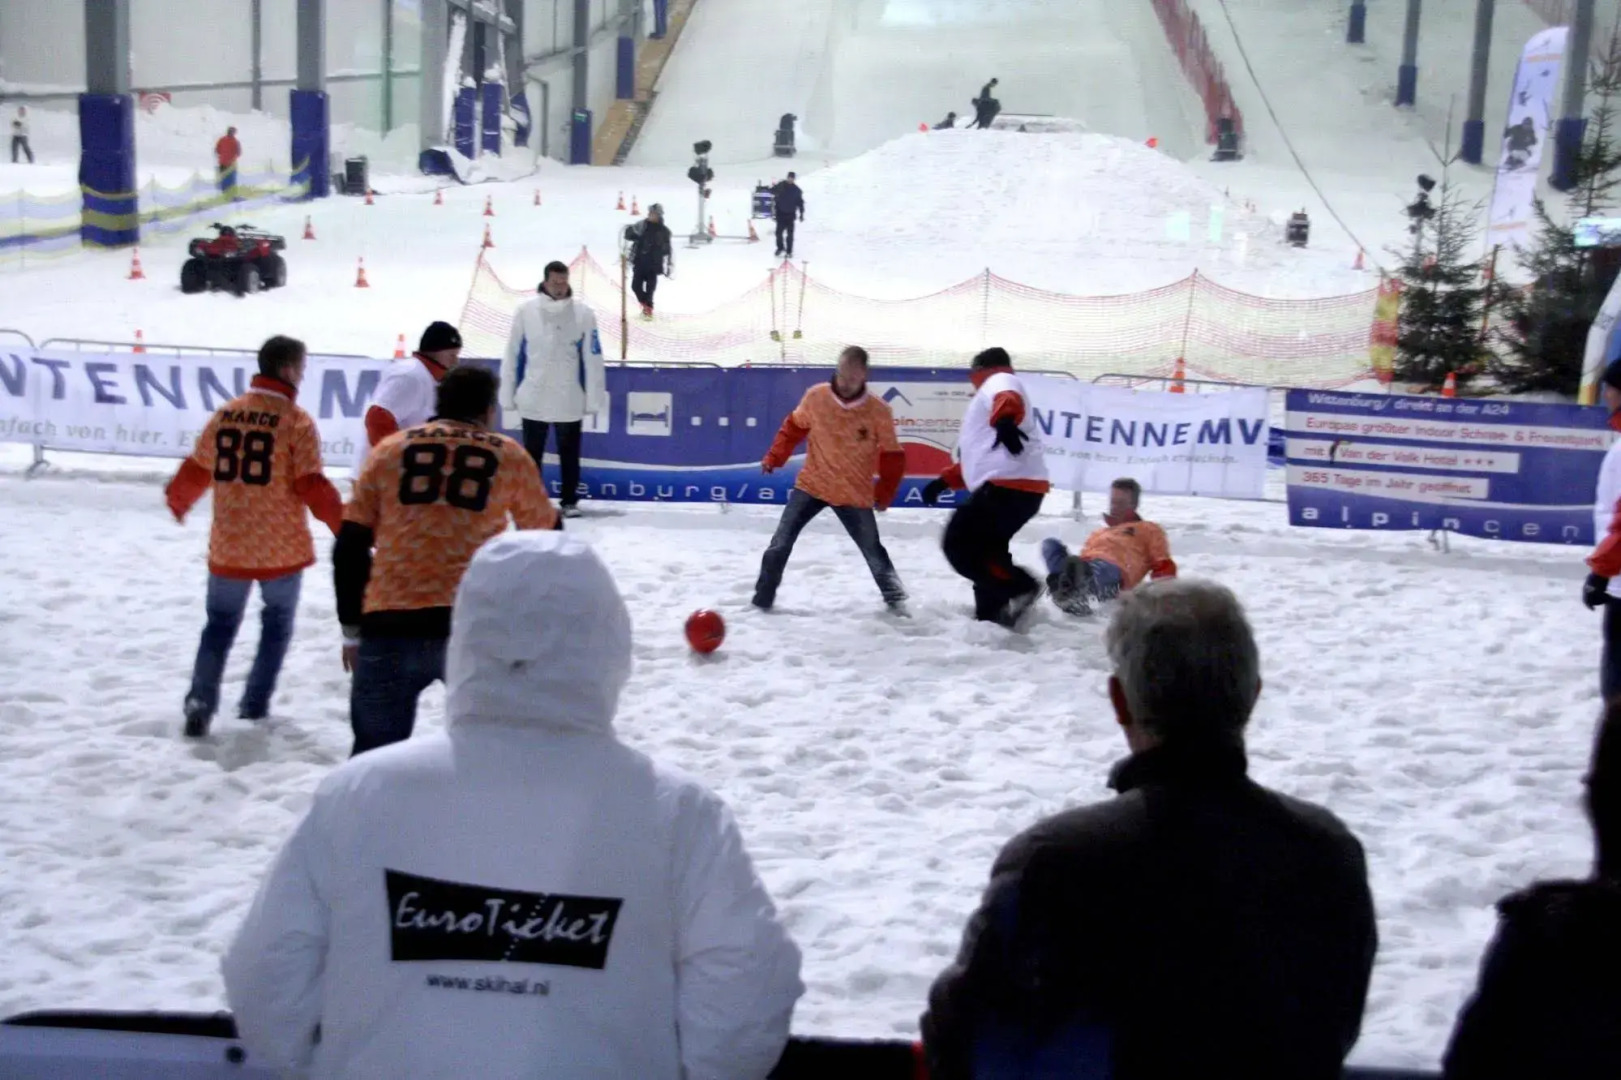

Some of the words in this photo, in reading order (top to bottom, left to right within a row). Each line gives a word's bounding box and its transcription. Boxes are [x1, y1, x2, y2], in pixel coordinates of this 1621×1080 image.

[1394, 399, 1433, 412] direkt
[1436, 403, 1452, 413] an
[1456, 404, 1479, 415] der
[1481, 404, 1510, 416] A24
[222, 410, 279, 428] MARCO
[1306, 417, 1358, 432] Europas
[1361, 422, 1410, 435] größter
[1514, 431, 1525, 442] &
[66, 424, 106, 440] von
[116, 424, 167, 446] hier.
[214, 428, 275, 486] 88
[1304, 446, 1325, 457] mit
[1340, 447, 1363, 459] Van
[1367, 449, 1388, 460] der
[1393, 451, 1419, 463] Valk
[1424, 454, 1458, 466] Hotel
[398, 443, 498, 512] 88
[1303, 471, 1329, 484] 365
[1334, 473, 1362, 488] Tage
[1366, 476, 1382, 486] im
[1386, 478, 1415, 490] Jahr
[396, 892, 608, 944] EuroTicket
